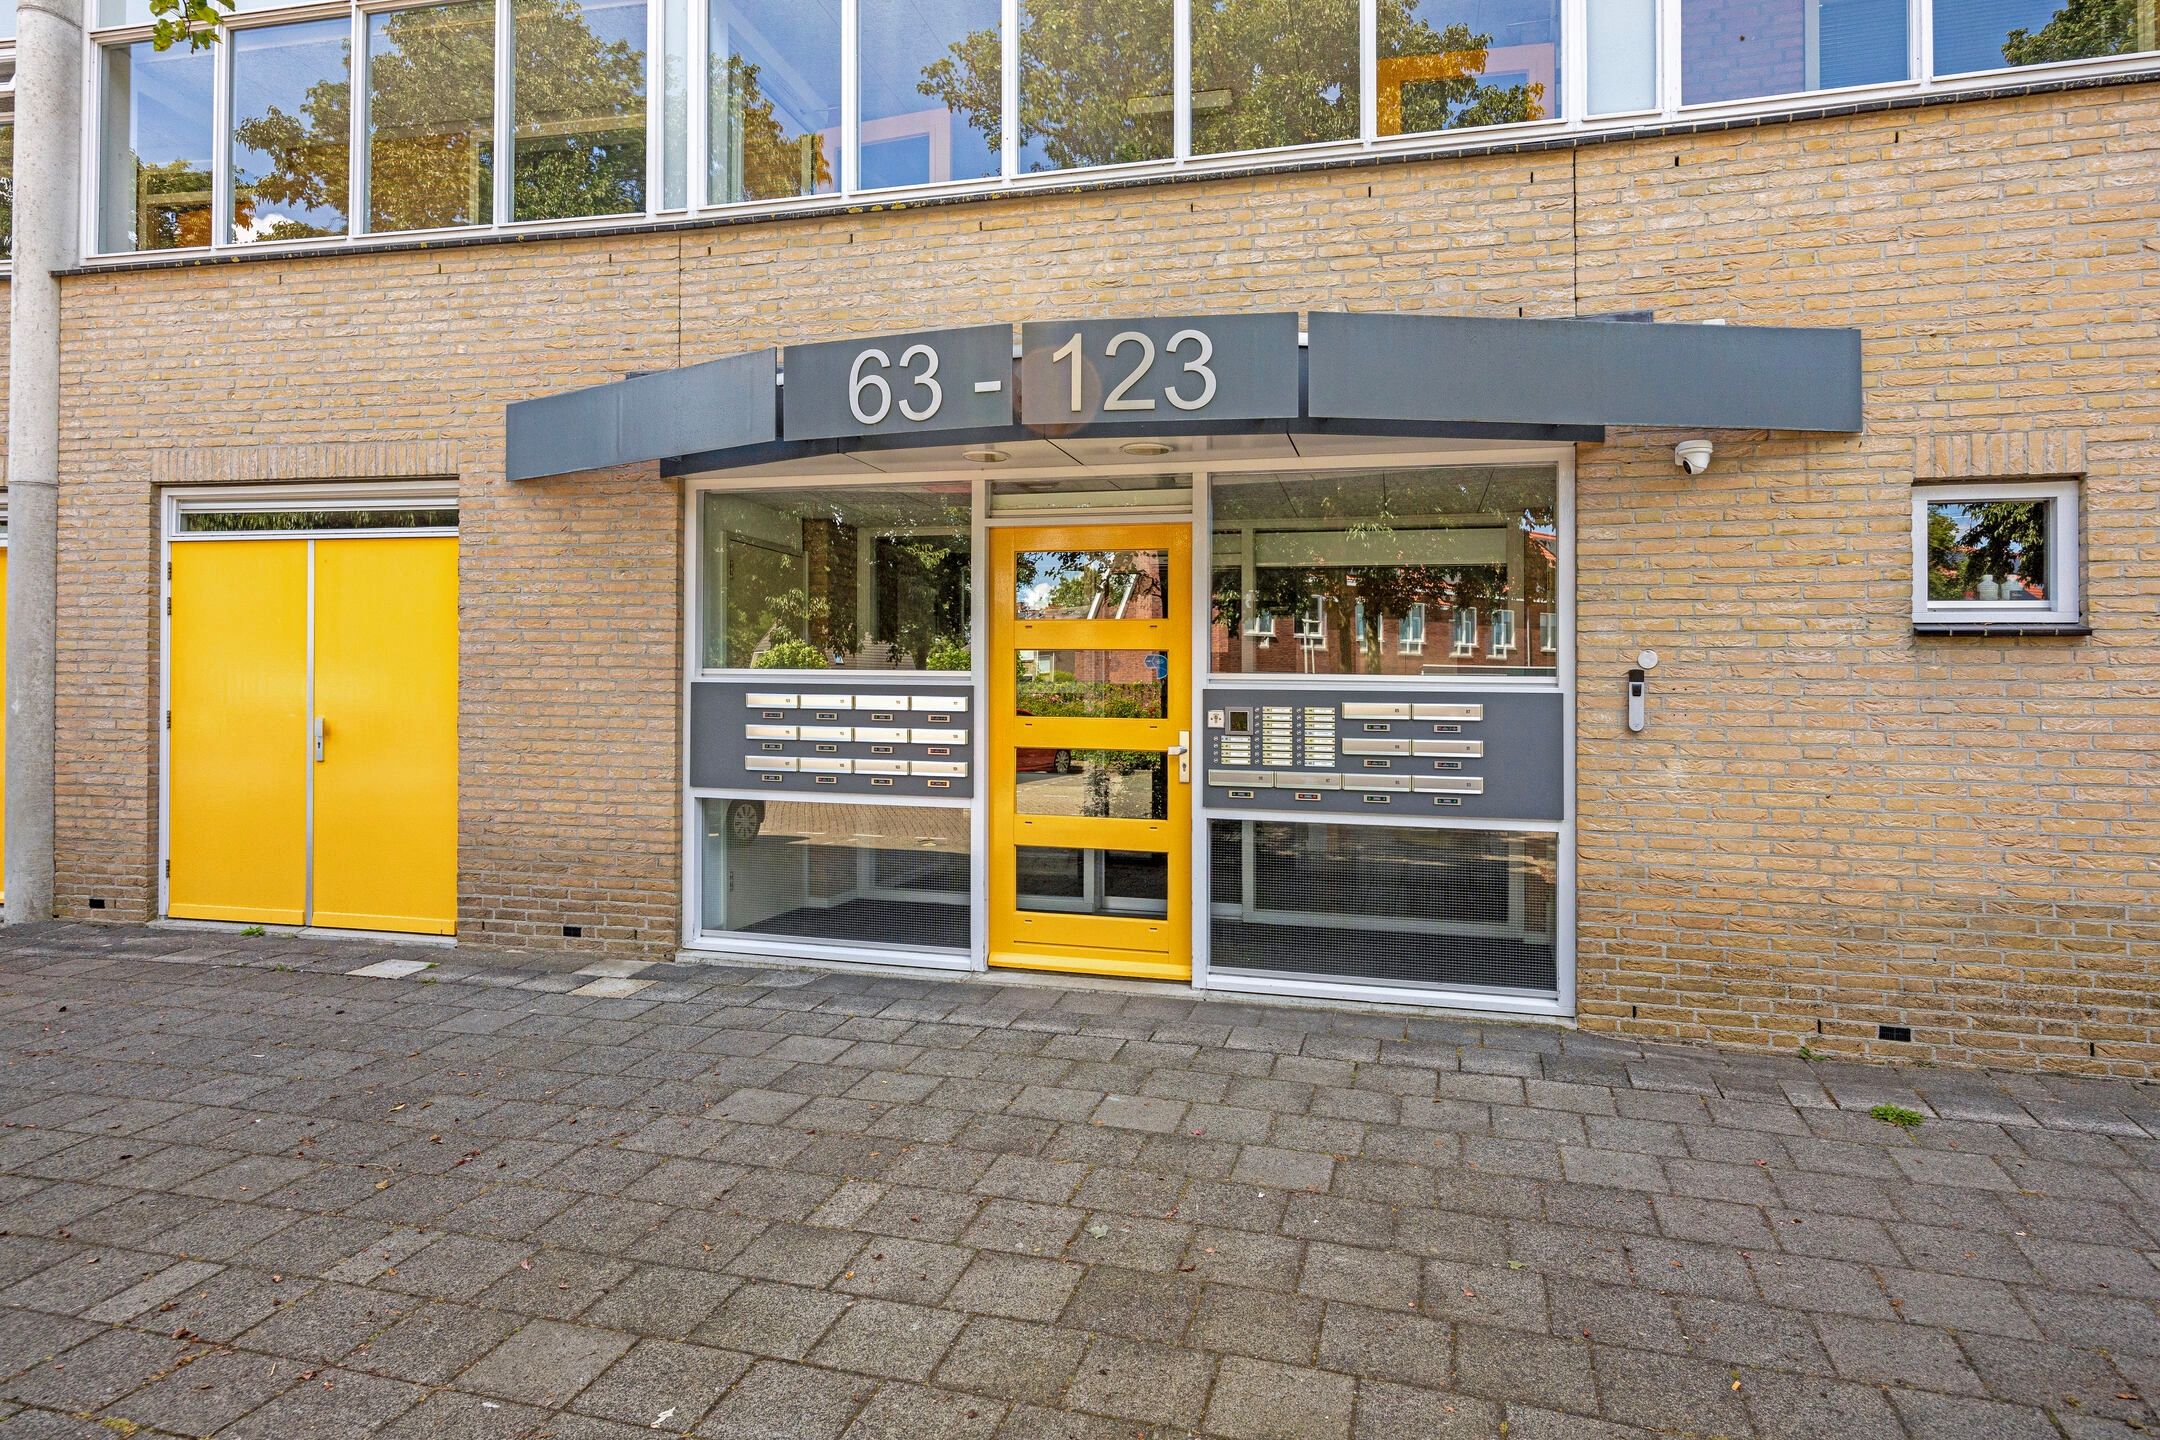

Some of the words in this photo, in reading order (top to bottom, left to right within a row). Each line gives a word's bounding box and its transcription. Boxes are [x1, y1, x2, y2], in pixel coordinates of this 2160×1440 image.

[848, 344, 943, 425] 63
[974, 380, 1002, 393] -
[1052, 329, 1217, 412] 123
